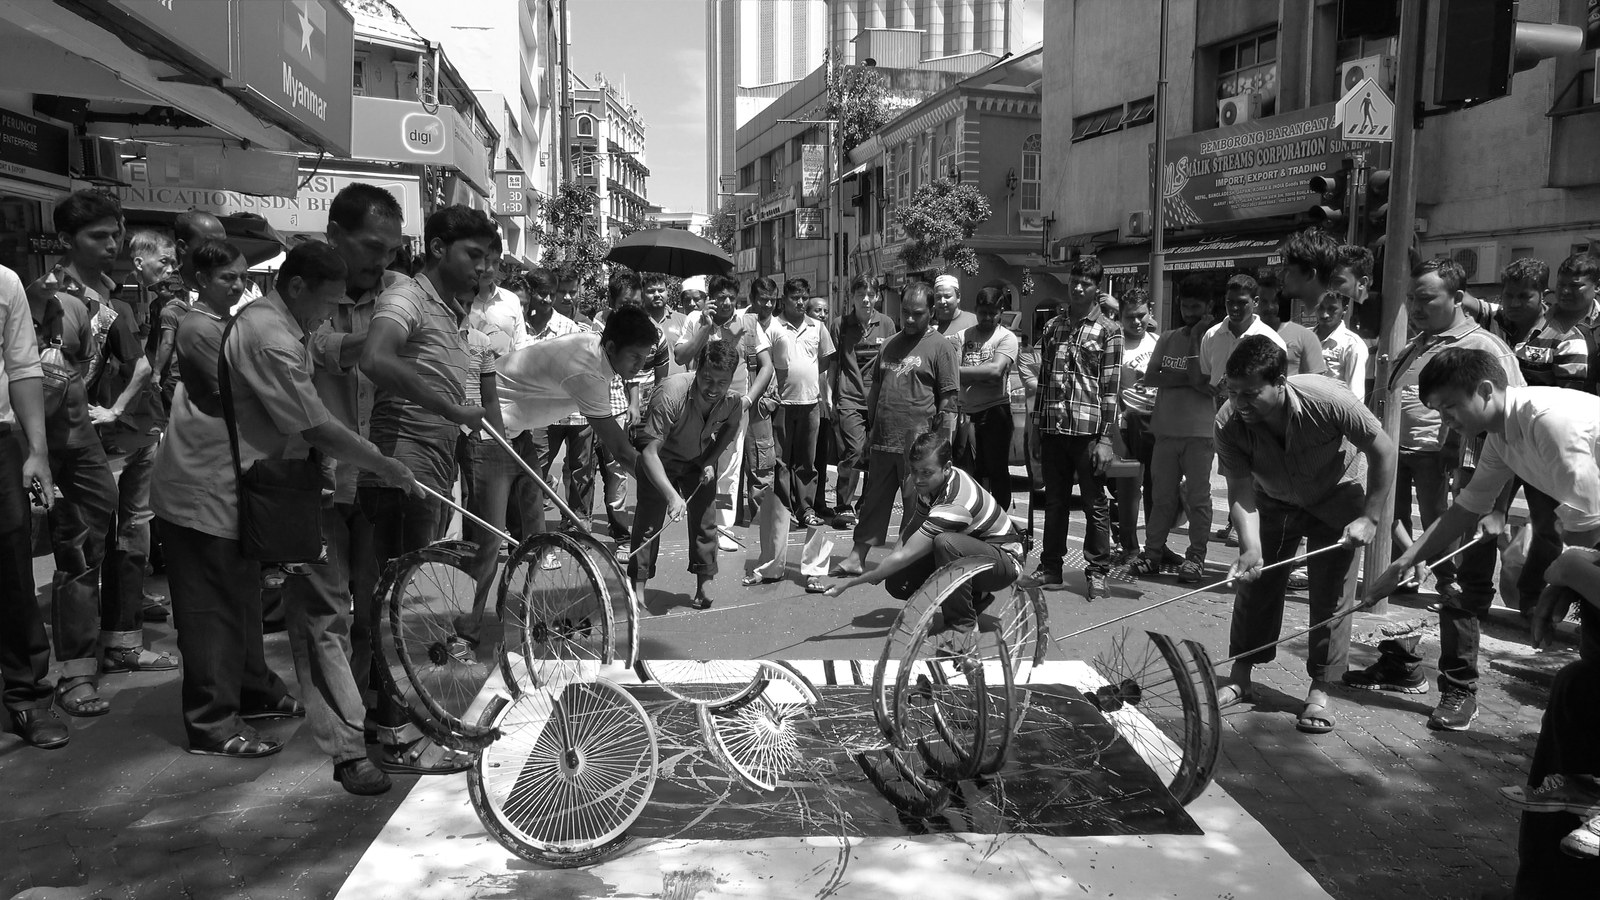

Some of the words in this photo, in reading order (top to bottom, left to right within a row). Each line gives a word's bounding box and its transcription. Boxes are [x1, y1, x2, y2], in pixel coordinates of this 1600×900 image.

[283, 61, 327, 121] Myanmar
[2, 115, 37, 135] PERUNCIT
[2, 133, 38, 151] ENTERPRISE
[409, 130, 432, 144] digi
[1200, 131, 1263, 154] PEMBORONG
[1266, 117, 1328, 141] BARANGAN
[1213, 151, 1253, 173] STREAMS
[1256, 137, 1327, 166] CORPORATION
[1215, 175, 1245, 187] IMPORT,
[1247, 170, 1278, 183] EXPORT
[1281, 168, 1286, 177] &
[1288, 162, 1327, 176] TRADING
[260, 195, 300, 210] SDN
[509, 191, 522, 201] 3D
